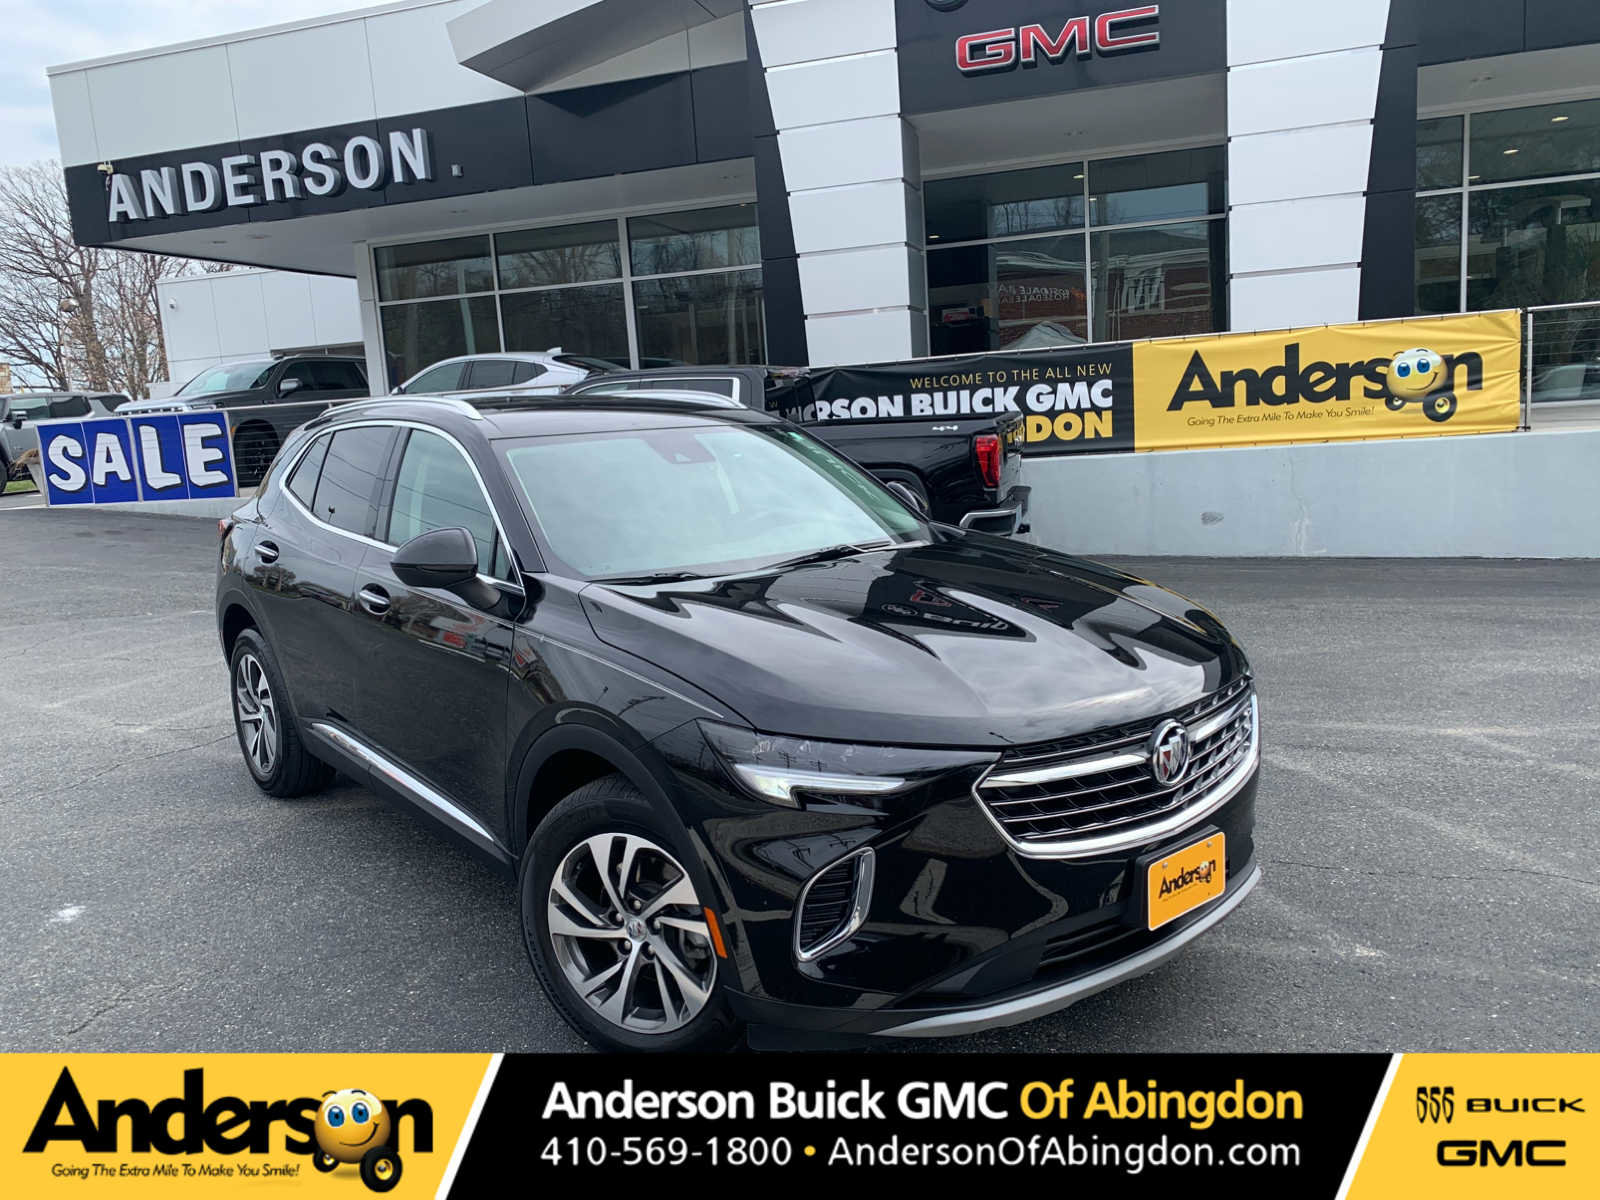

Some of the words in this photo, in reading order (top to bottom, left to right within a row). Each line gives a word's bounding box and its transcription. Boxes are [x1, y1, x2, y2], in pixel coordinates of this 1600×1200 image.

[956, 4, 1160, 74] GMC
[108, 127, 432, 223] ANDERSON
[909, 373, 983, 390] WELCOME
[987, 371, 1007, 384] TO
[1012, 368, 1039, 382] THE
[1045, 367, 1072, 380] ALL
[1077, 363, 1112, 378] NEW
[801, 394, 904, 421] RSON
[911, 385, 1024, 417] BUICK
[1026, 379, 1113, 413] GMC
[1187, 415, 1216, 427] Going
[1217, 414, 1235, 425] The
[1236, 413, 1260, 424] Extra
[1261, 411, 1281, 422] Mile
[1283, 410, 1295, 421] To
[1296, 408, 1323, 420] Make
[1325, 407, 1343, 418] You
[1345, 405, 1376, 417] Smile!
[1022, 410, 1113, 443] DON
[48, 423, 229, 492] SALE
